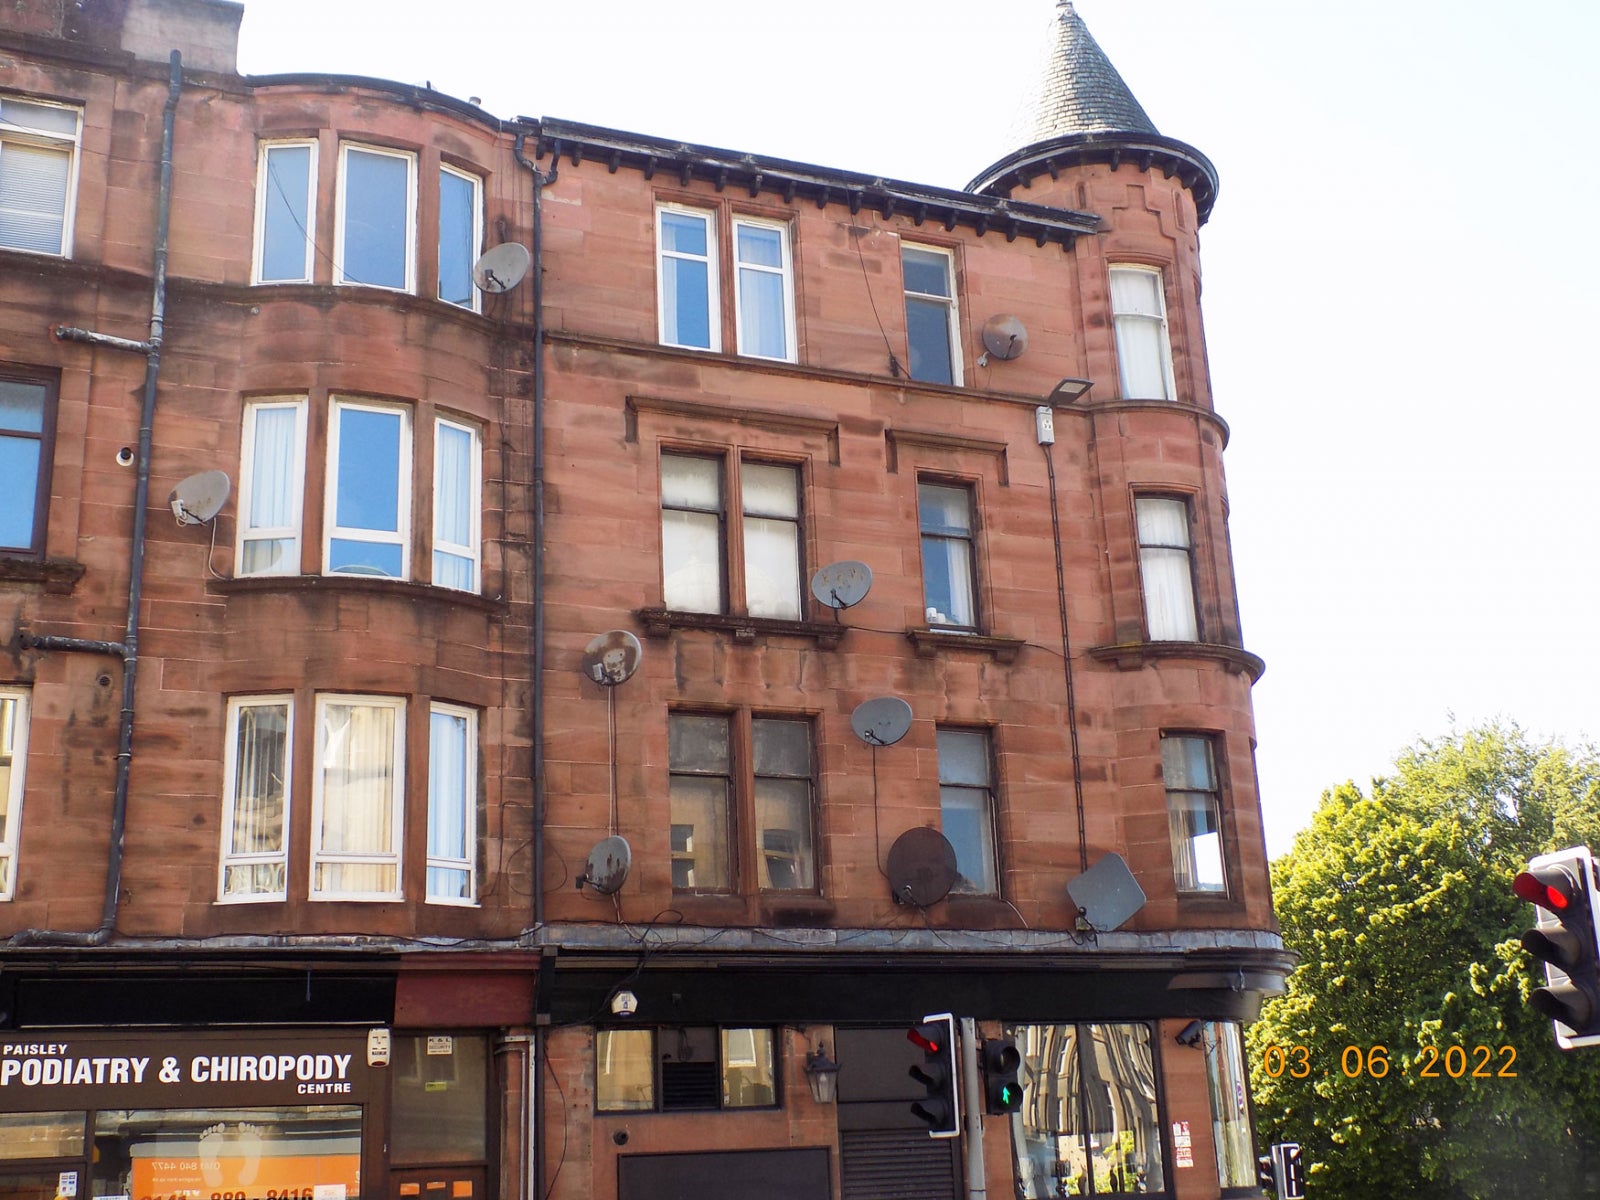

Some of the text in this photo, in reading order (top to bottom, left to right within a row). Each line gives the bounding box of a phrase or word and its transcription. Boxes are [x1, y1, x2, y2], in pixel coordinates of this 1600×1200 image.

[3, 1044, 68, 1055] PAISLEY
[0, 1054, 352, 1086] PODIATRY & CHIROPODY
[297, 1082, 351, 1094] CENTRE
